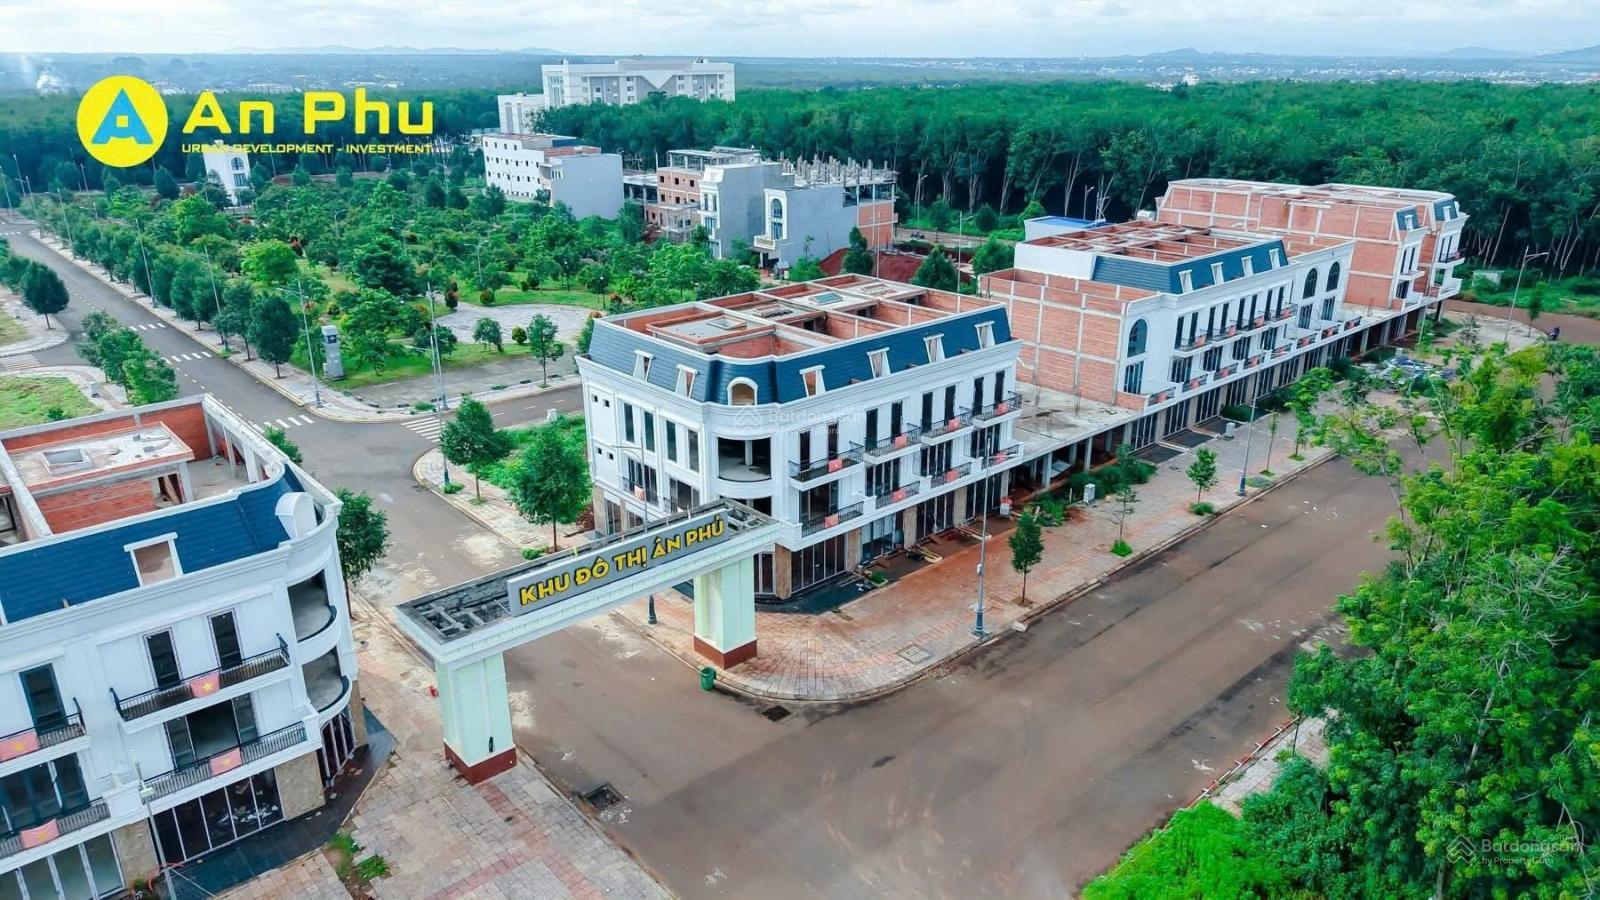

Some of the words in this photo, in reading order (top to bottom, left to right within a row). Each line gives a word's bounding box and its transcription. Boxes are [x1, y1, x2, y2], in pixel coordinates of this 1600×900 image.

[520, 573, 570, 605] KHU
[574, 558, 610, 586] ĐÔ
[613, 546, 648, 571] THỊ
[685, 515, 725, 547] PHÚ
